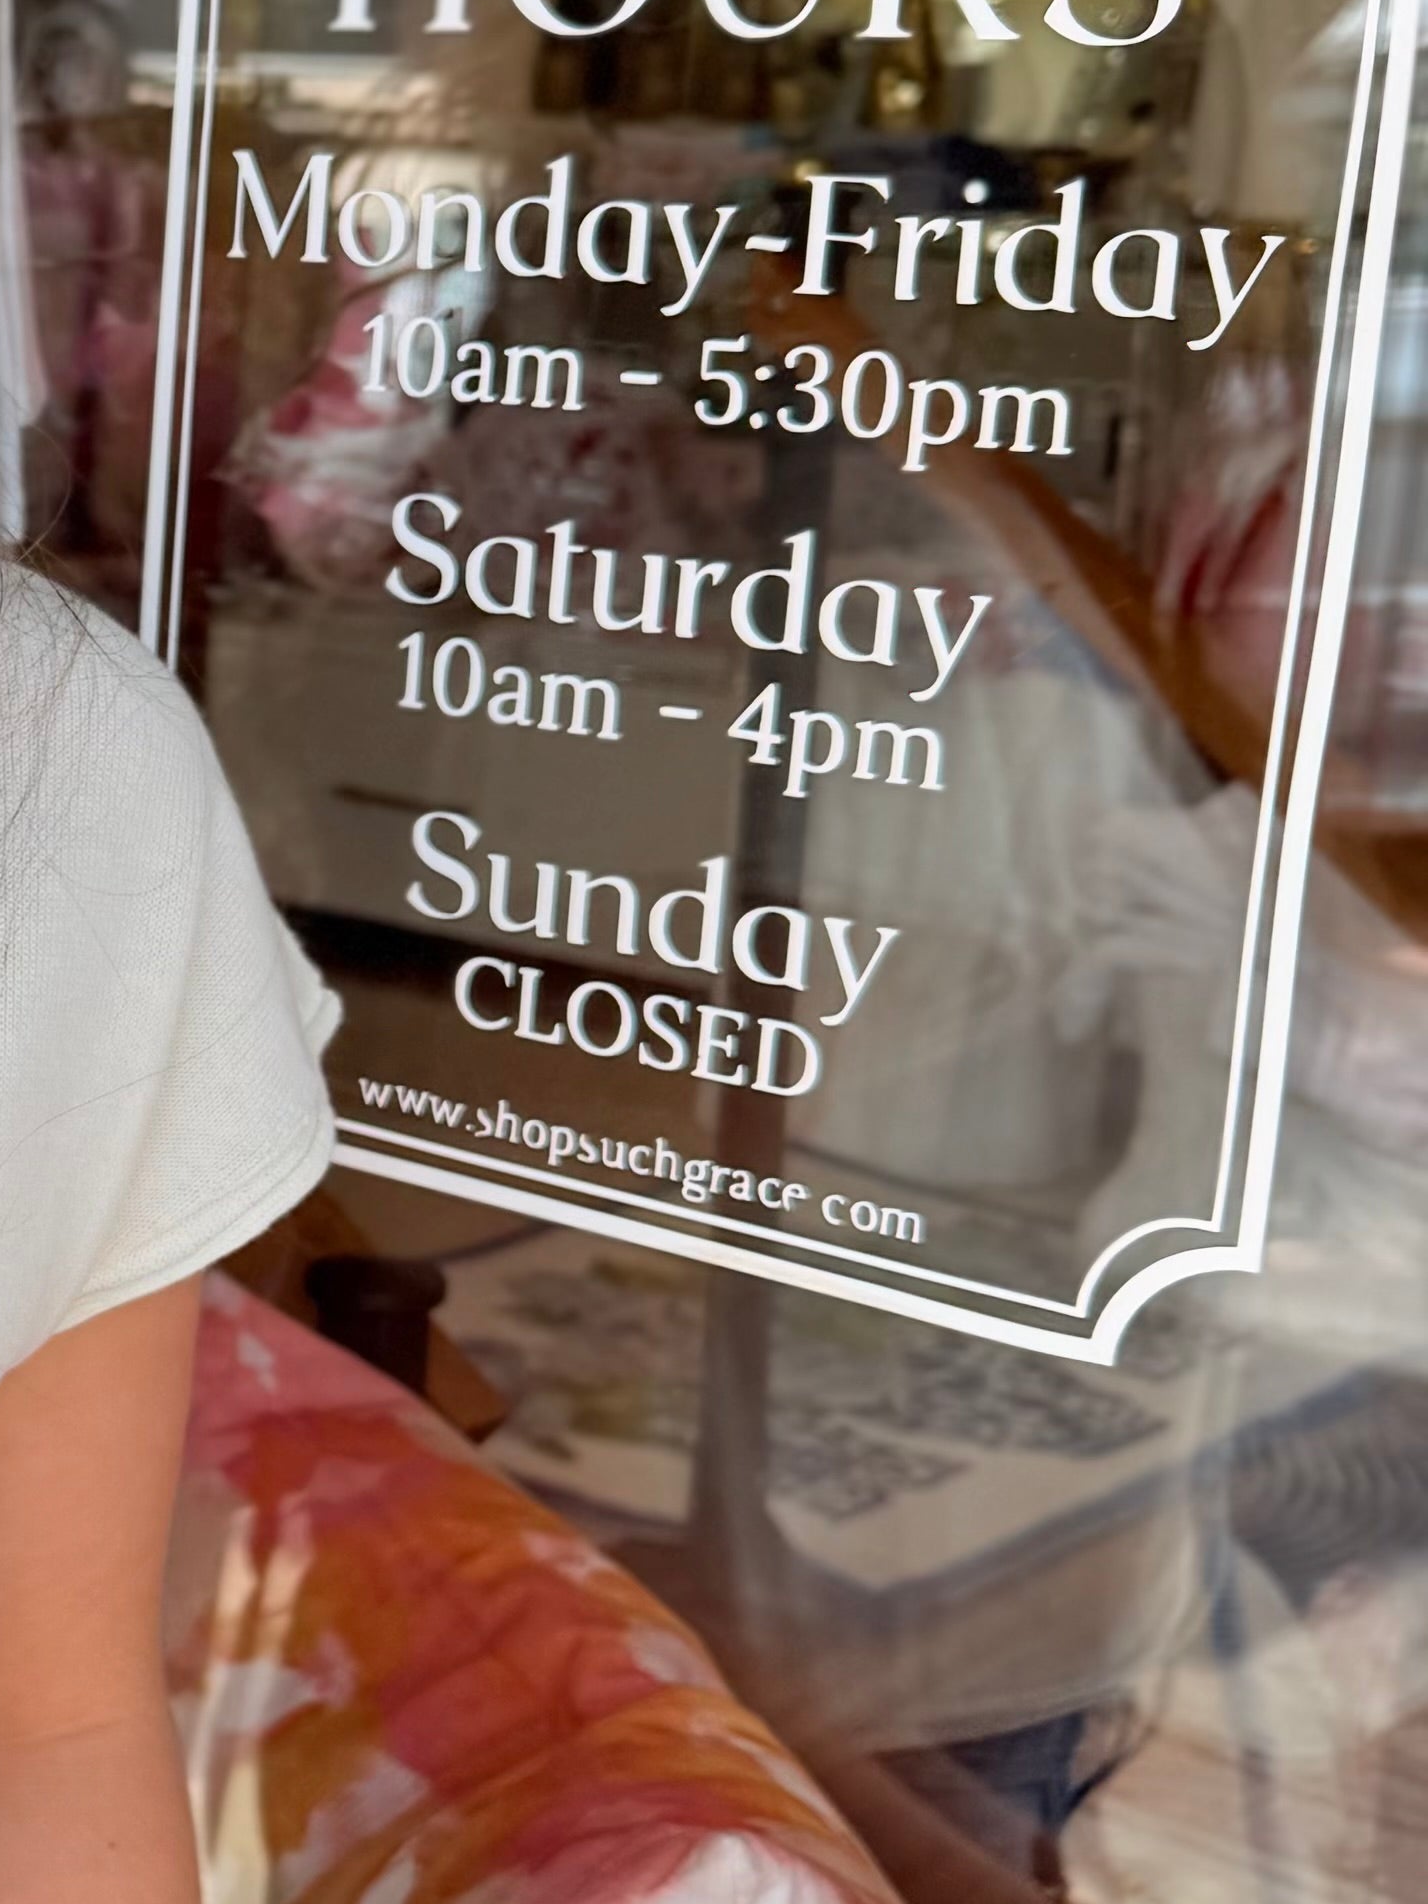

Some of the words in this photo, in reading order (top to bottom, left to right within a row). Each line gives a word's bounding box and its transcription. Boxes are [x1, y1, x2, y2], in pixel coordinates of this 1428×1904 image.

[226, 150, 1288, 351] Monday-Friday
[359, 314, 585, 412] 10am
[693, 336, 1074, 472] 5:30pm
[385, 493, 992, 702] Saturday
[396, 631, 622, 743] 10am
[727, 682, 946, 799] 4pm
[405, 810, 901, 1027] Sunday
[453, 955, 823, 1099] CLOSED
[358, 1077, 926, 1244] www.shopsuchgracecom
